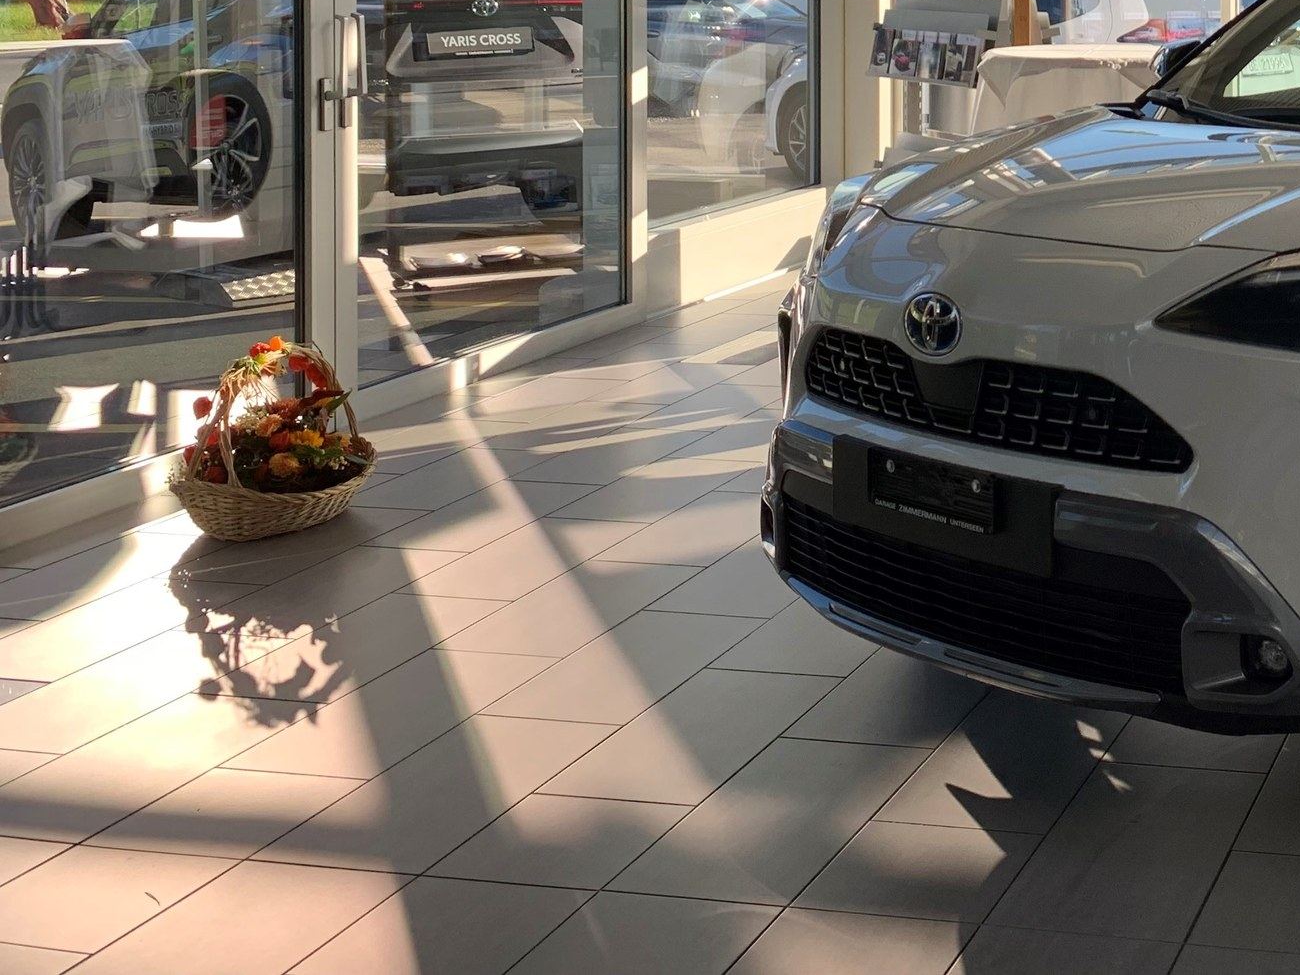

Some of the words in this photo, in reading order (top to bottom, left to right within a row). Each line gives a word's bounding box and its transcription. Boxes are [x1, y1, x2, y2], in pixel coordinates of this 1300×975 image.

[441, 35, 477, 48] YARIS
[479, 33, 522, 45] CROSS
[874, 498, 896, 510] GARAGE
[898, 504, 947, 524] ZIMMERMANN
[949, 518, 984, 534] UNTERSEEN
